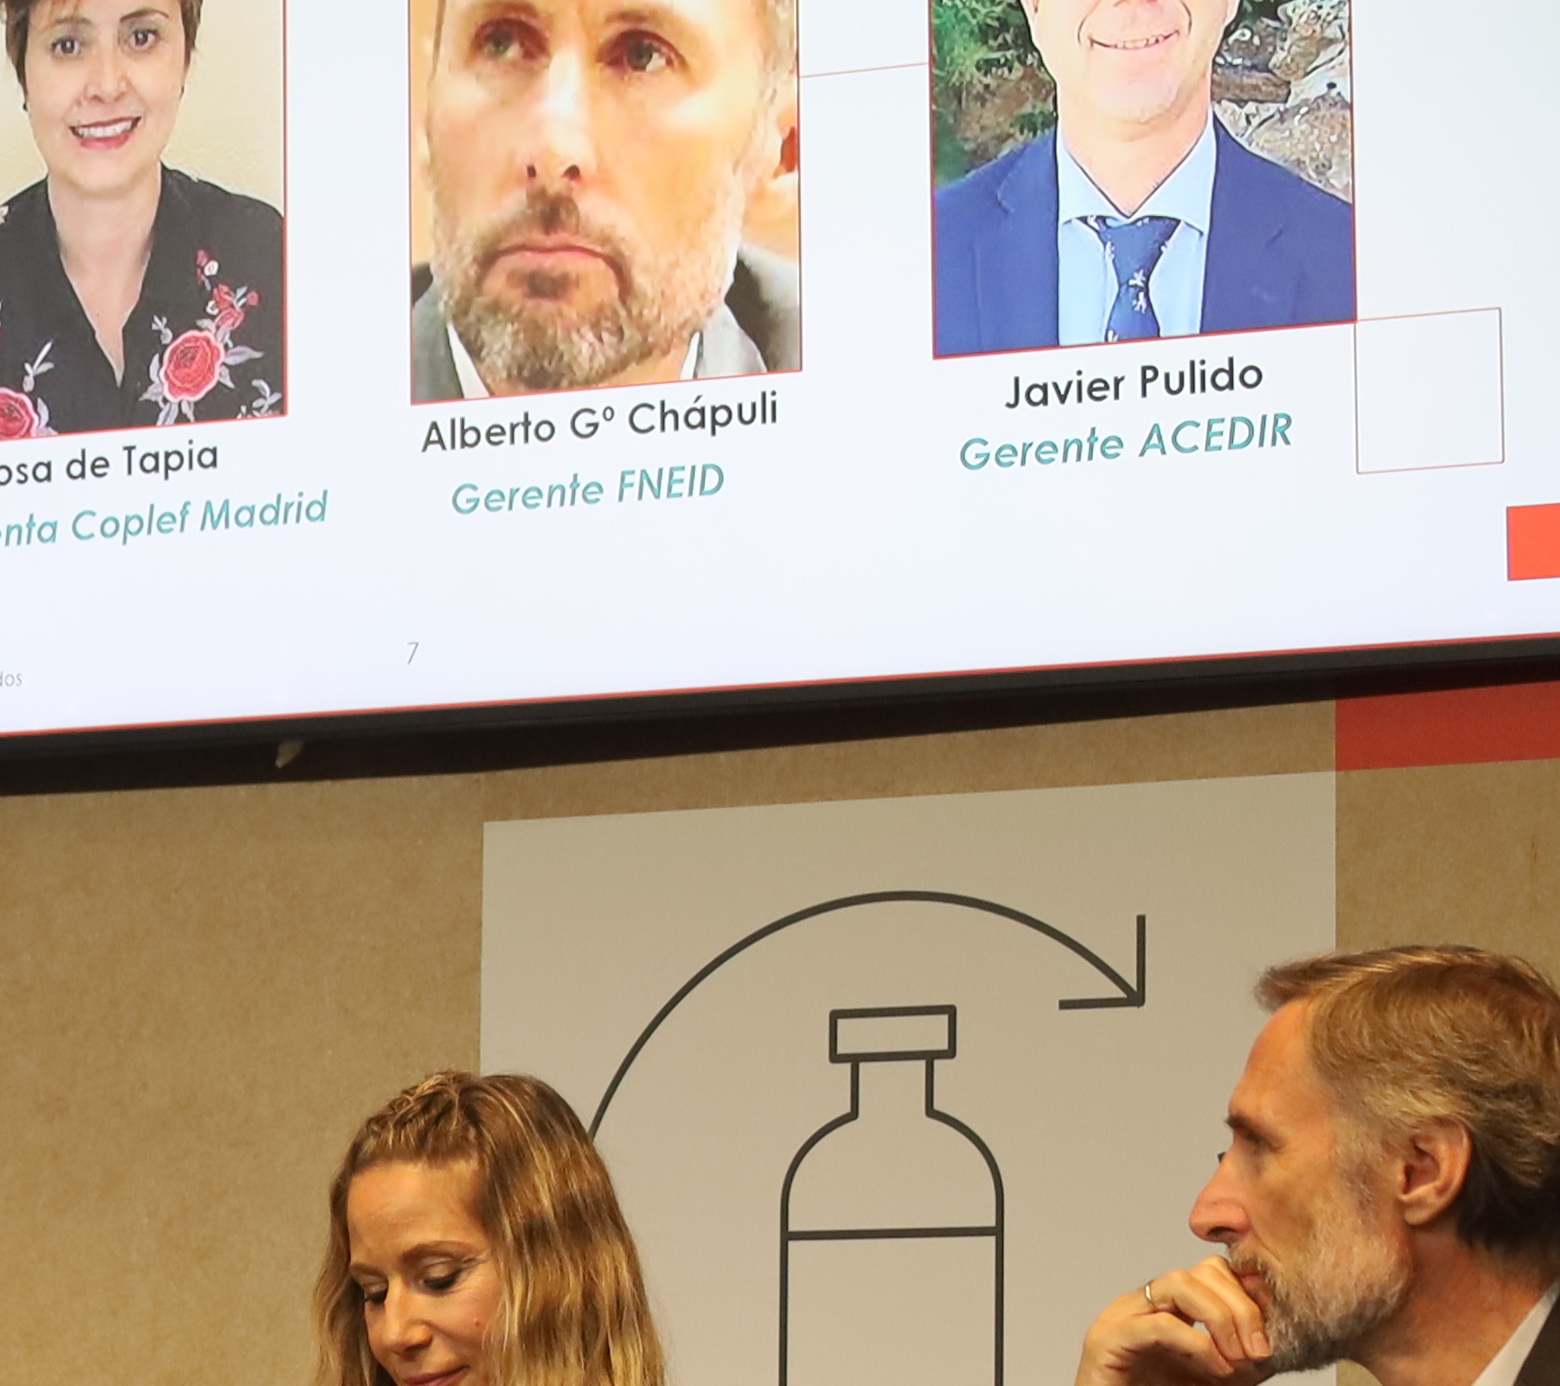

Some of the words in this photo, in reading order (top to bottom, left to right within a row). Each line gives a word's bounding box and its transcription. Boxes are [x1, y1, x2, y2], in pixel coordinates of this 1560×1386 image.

[1004, 369, 1125, 412] Javier
[1140, 356, 1264, 400] Pulido
[420, 408, 556, 454] Alberto
[627, 391, 779, 440] Chápuli
[958, 425, 1125, 473] Gerente
[1138, 412, 1293, 458] ACEDIR
[66, 447, 111, 481] de
[123, 440, 219, 481] Tapia
[451, 473, 605, 516] Gerente
[616, 463, 725, 504] FNEID
[72, 501, 192, 548] Coplef
[199, 490, 330, 532] Madrid
[406, 641, 419, 666] 7
